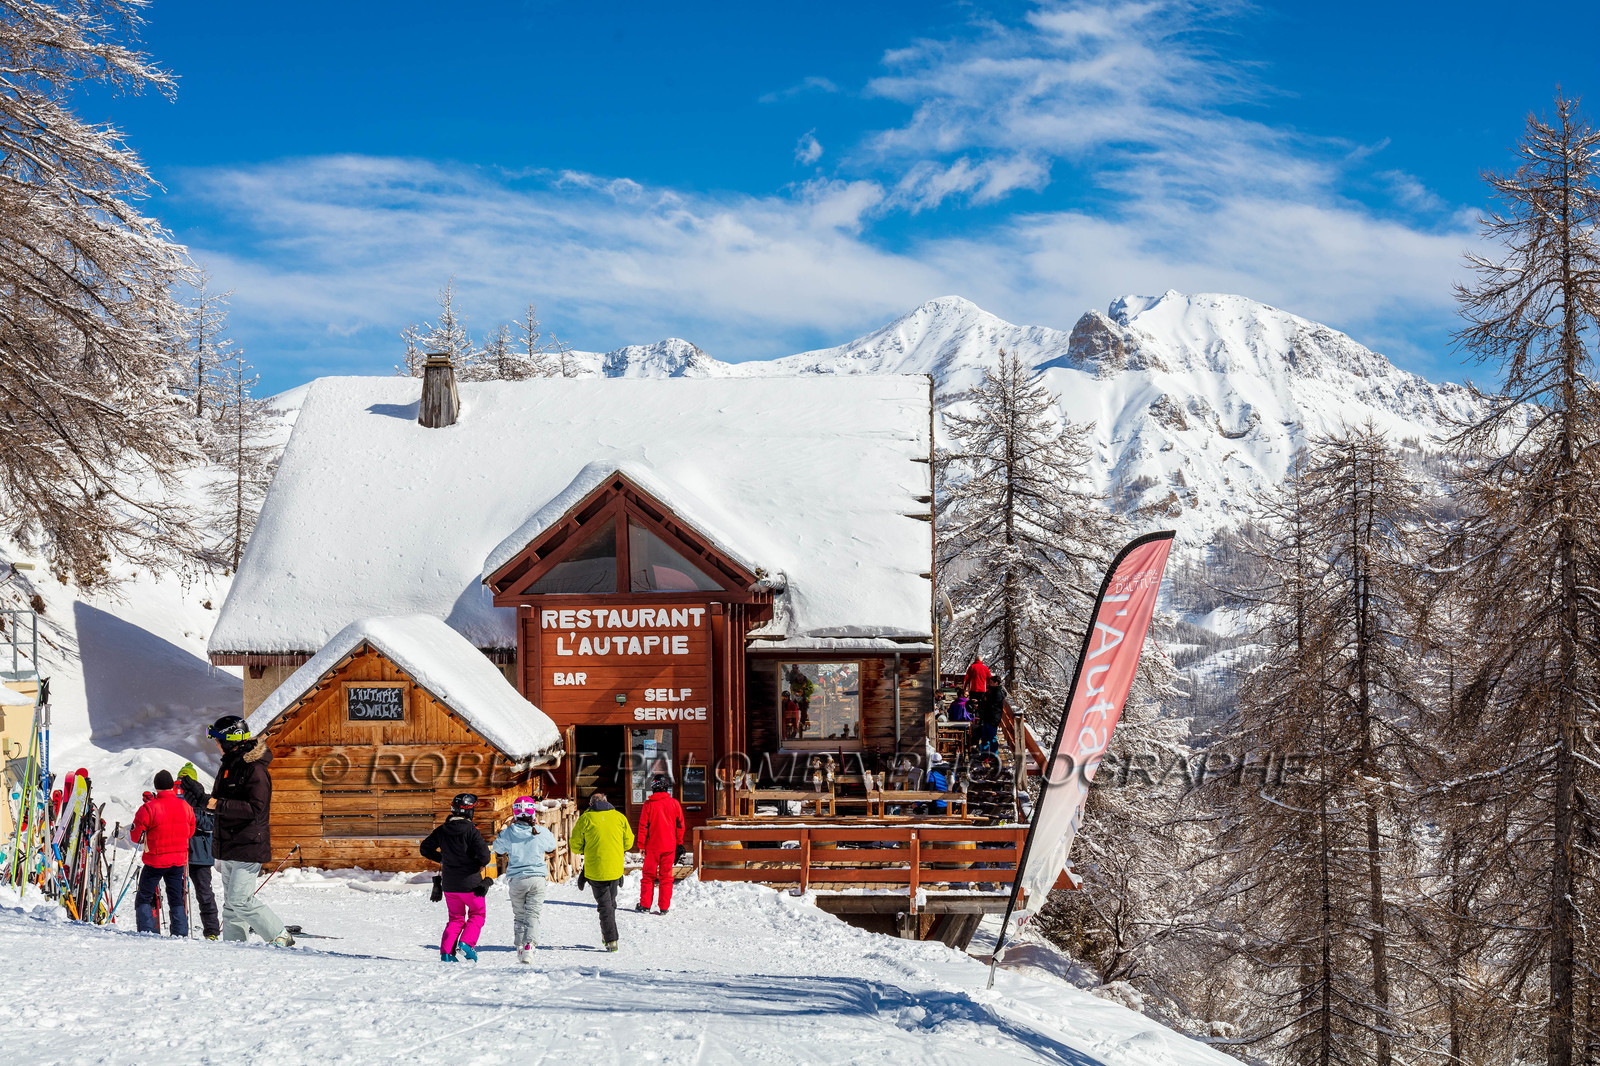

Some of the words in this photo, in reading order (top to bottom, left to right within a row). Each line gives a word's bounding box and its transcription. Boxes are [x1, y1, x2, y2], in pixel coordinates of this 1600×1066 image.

[541, 608, 706, 629] RESTAURANT
[557, 632, 690, 656] L'AUTAPIE
[553, 672, 587, 686] BAR
[350, 688, 400, 703] L'AUTAPIE
[644, 688, 692, 702] SELF
[634, 707, 707, 721] SERVICE
